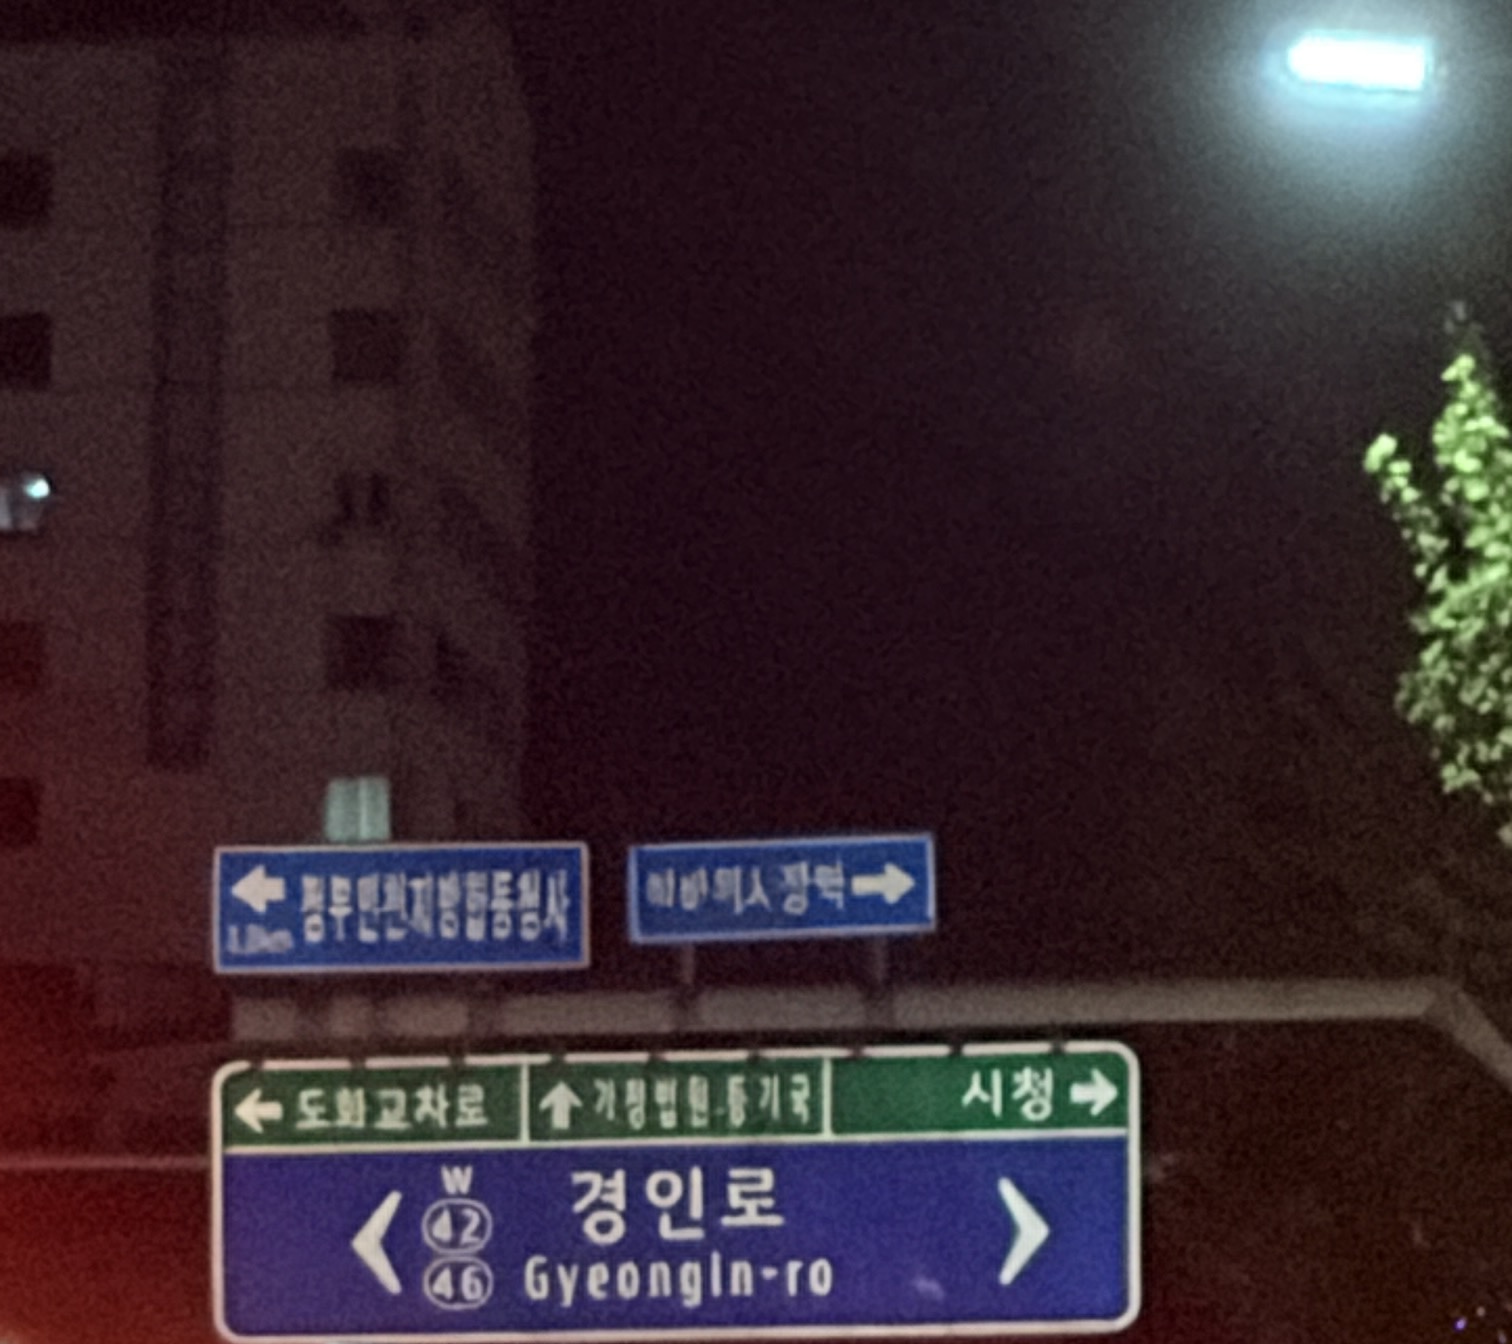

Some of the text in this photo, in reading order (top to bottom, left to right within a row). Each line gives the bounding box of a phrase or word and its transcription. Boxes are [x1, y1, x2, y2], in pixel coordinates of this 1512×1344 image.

[295, 1082, 489, 1131] 도화교차로
[961, 1067, 1056, 1123] 시청
[440, 1165, 474, 1195] W
[432, 1207, 482, 1244] 42
[571, 1166, 786, 1246] 경인로
[433, 1265, 484, 1302] 46
[524, 1253, 834, 1308] Gyeongin-ro
